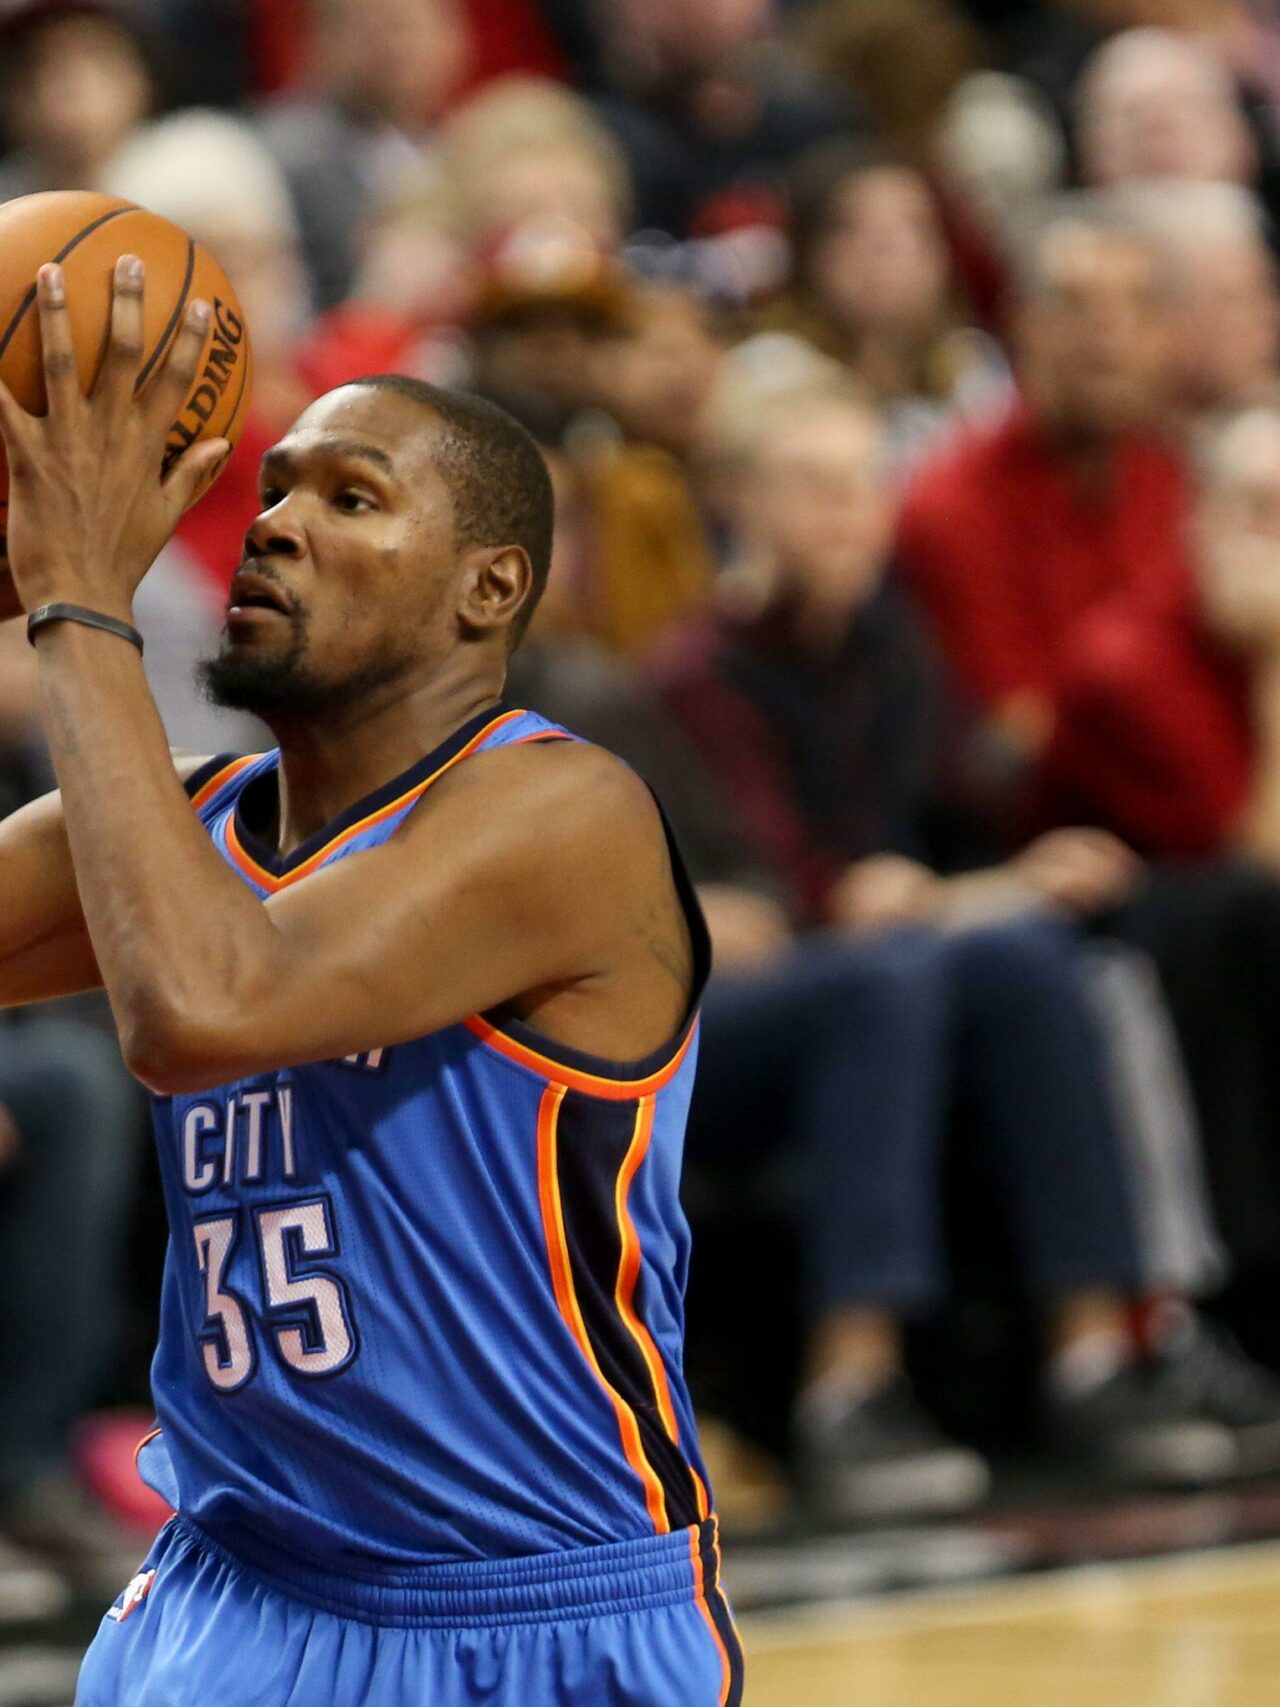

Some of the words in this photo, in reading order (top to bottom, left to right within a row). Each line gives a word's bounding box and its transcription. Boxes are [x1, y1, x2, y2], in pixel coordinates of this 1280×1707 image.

[159, 296, 244, 486] ALDING
[183, 1085, 295, 1190] CITY
[191, 1197, 356, 1392] 35
